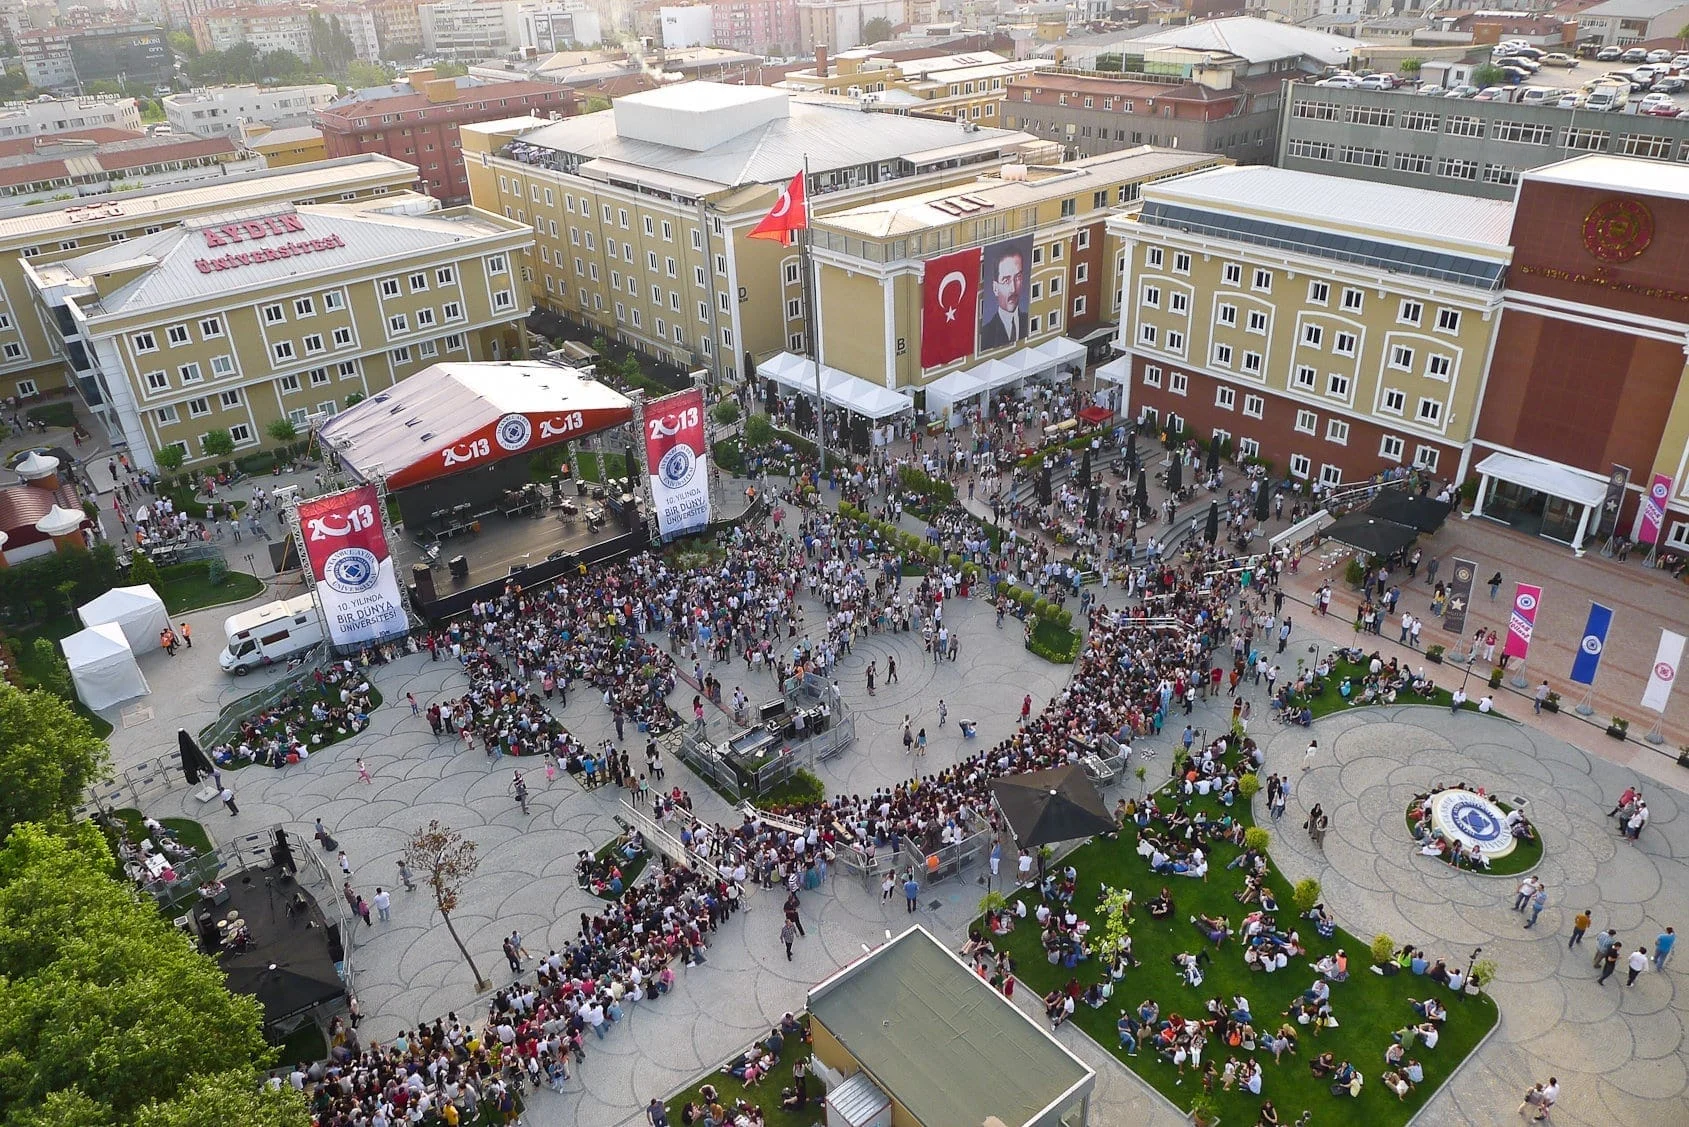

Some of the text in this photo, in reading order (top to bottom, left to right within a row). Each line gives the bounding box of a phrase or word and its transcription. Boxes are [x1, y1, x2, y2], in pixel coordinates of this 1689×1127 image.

[203, 213, 305, 248] AYDIN
[194, 233, 345, 274] ÜNİVERSİTESİ
[738, 287, 747, 298] D
[897, 337, 905, 351] B
[540, 412, 583, 438] 2013
[649, 407, 698, 440] 2013
[442, 438, 490, 467] 2013
[308, 504, 374, 541] 2013
[337, 601, 394, 624] BİR DÜNYA
[338, 602, 350, 612] 10.
[340, 611, 398, 633] ÜNİVERSİTESİ
